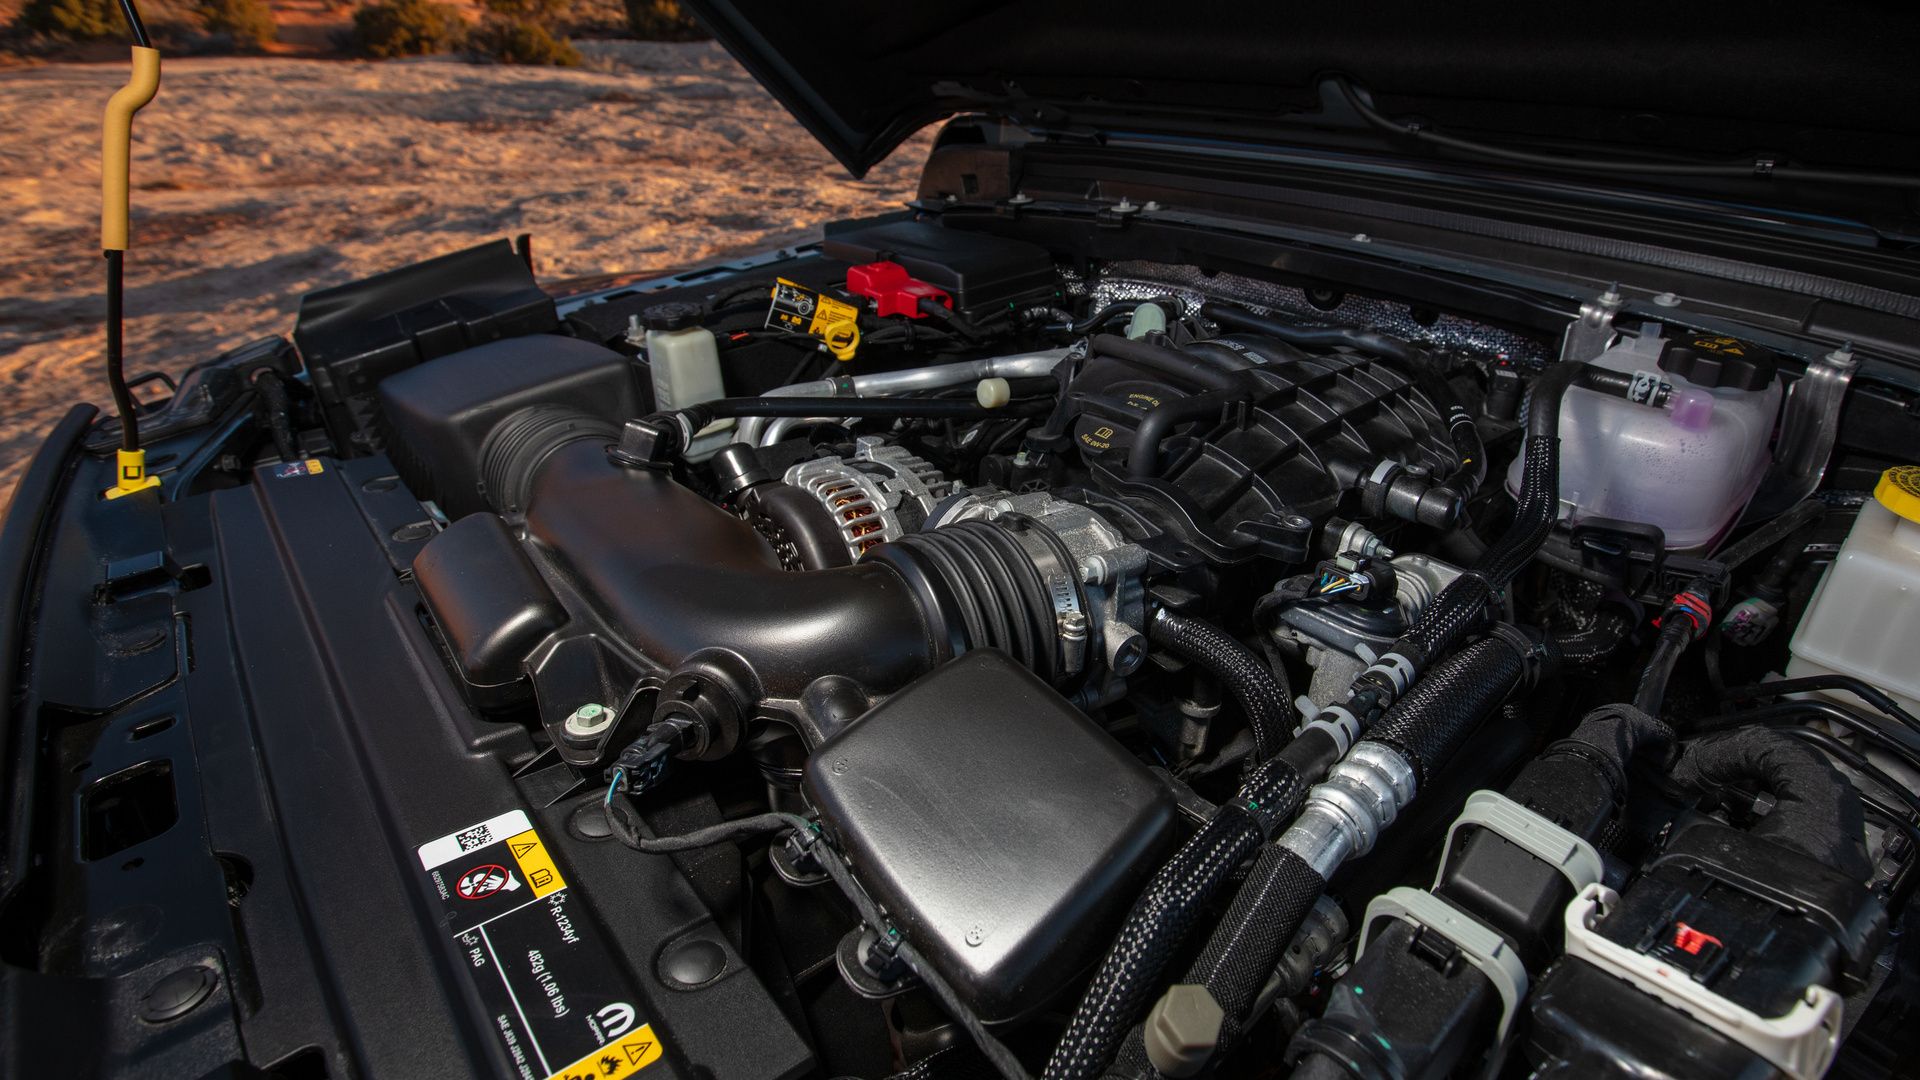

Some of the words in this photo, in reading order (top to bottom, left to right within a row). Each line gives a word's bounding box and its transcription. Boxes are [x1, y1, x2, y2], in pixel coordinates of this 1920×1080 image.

[1081, 433, 1092, 444] SAE
[550, 906, 580, 944] R-1234yf
[469, 947, 485, 967] PAG
[528, 950, 545, 974] 482g
[536, 972, 559, 997] (1.06
[550, 995, 570, 1018] lbs)
[497, 1014, 511, 1031] SAE
[585, 1014, 606, 1046] MOPAR
